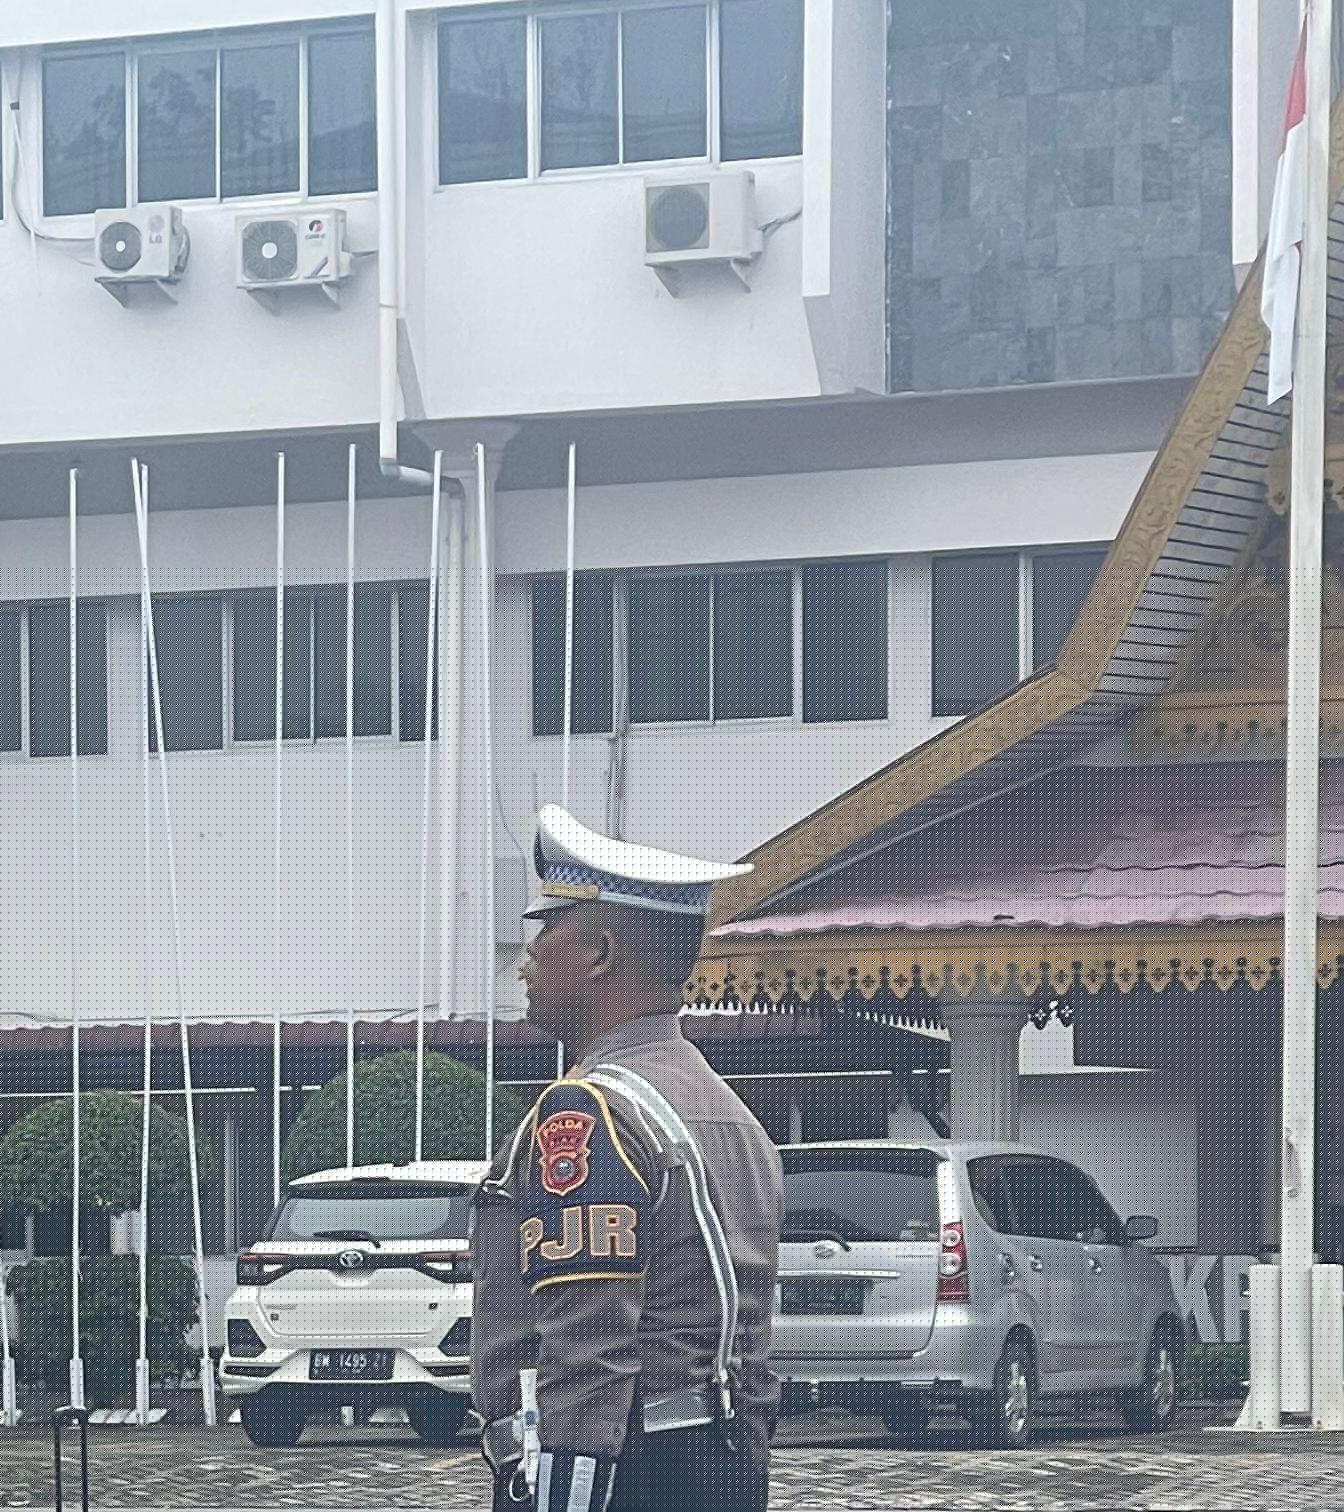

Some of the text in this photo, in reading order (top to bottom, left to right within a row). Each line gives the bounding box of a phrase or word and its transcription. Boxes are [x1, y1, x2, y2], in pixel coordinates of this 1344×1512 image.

[543, 1118, 584, 1138] POLDA
[520, 1204, 637, 1274] PJR
[339, 1353, 367, 1368] 1495
